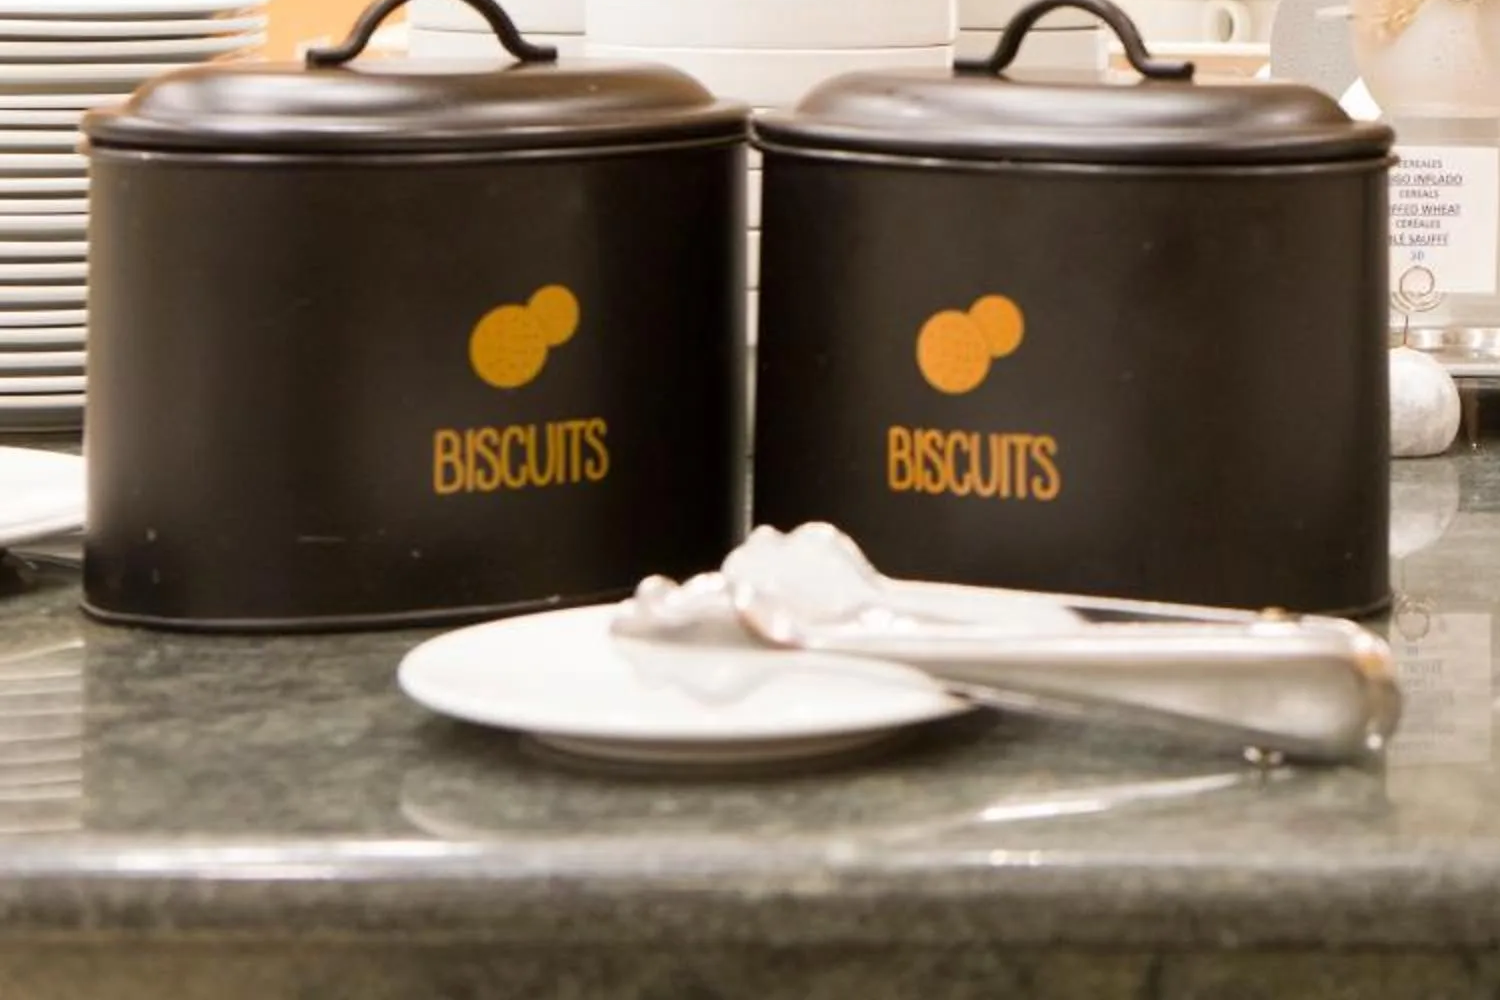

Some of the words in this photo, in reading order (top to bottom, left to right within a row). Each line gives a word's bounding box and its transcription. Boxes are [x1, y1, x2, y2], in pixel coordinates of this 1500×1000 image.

[1421, 203, 1461, 216] WHEAT
[434, 416, 610, 495] BISCUITS
[888, 424, 1061, 502] BISCUITS
